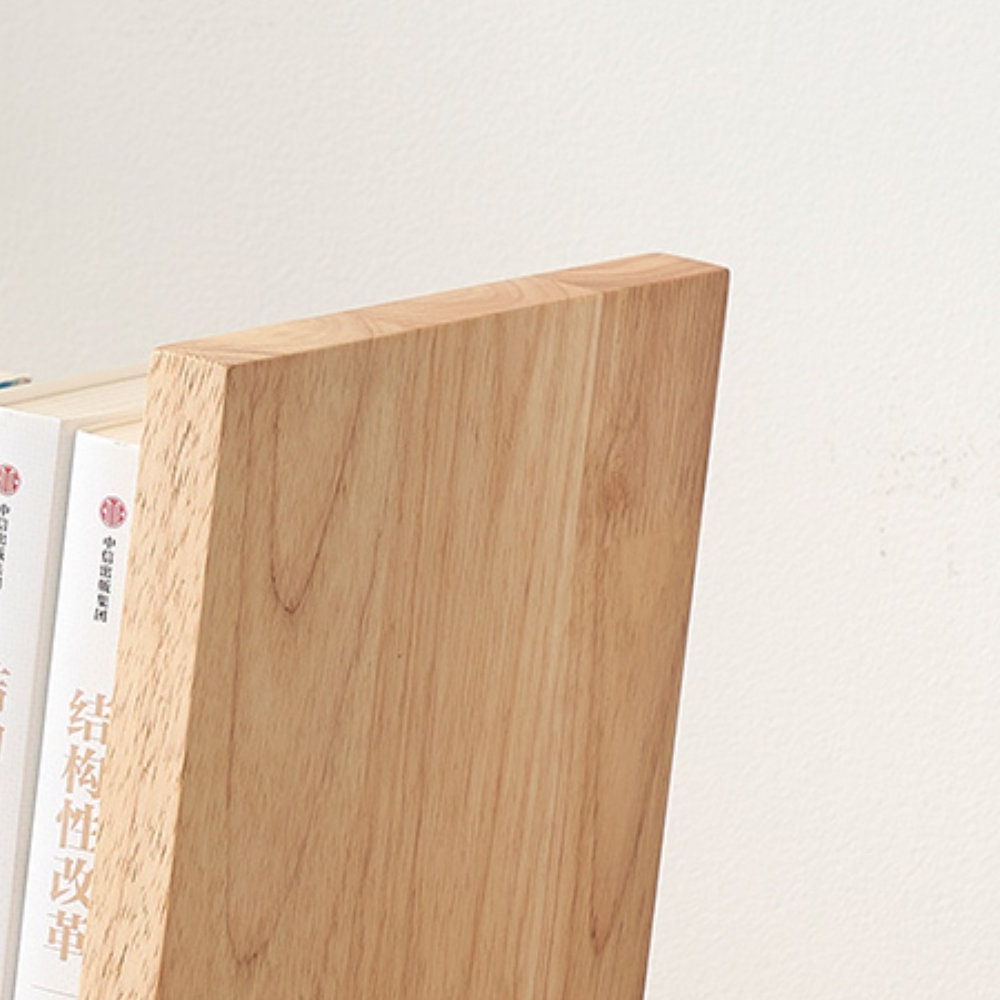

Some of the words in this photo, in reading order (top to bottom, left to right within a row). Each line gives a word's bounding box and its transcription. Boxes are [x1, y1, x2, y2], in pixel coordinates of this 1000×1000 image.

[94, 536, 116, 623] 中信出版集团
[43, 689, 112, 962] 结构性改革
